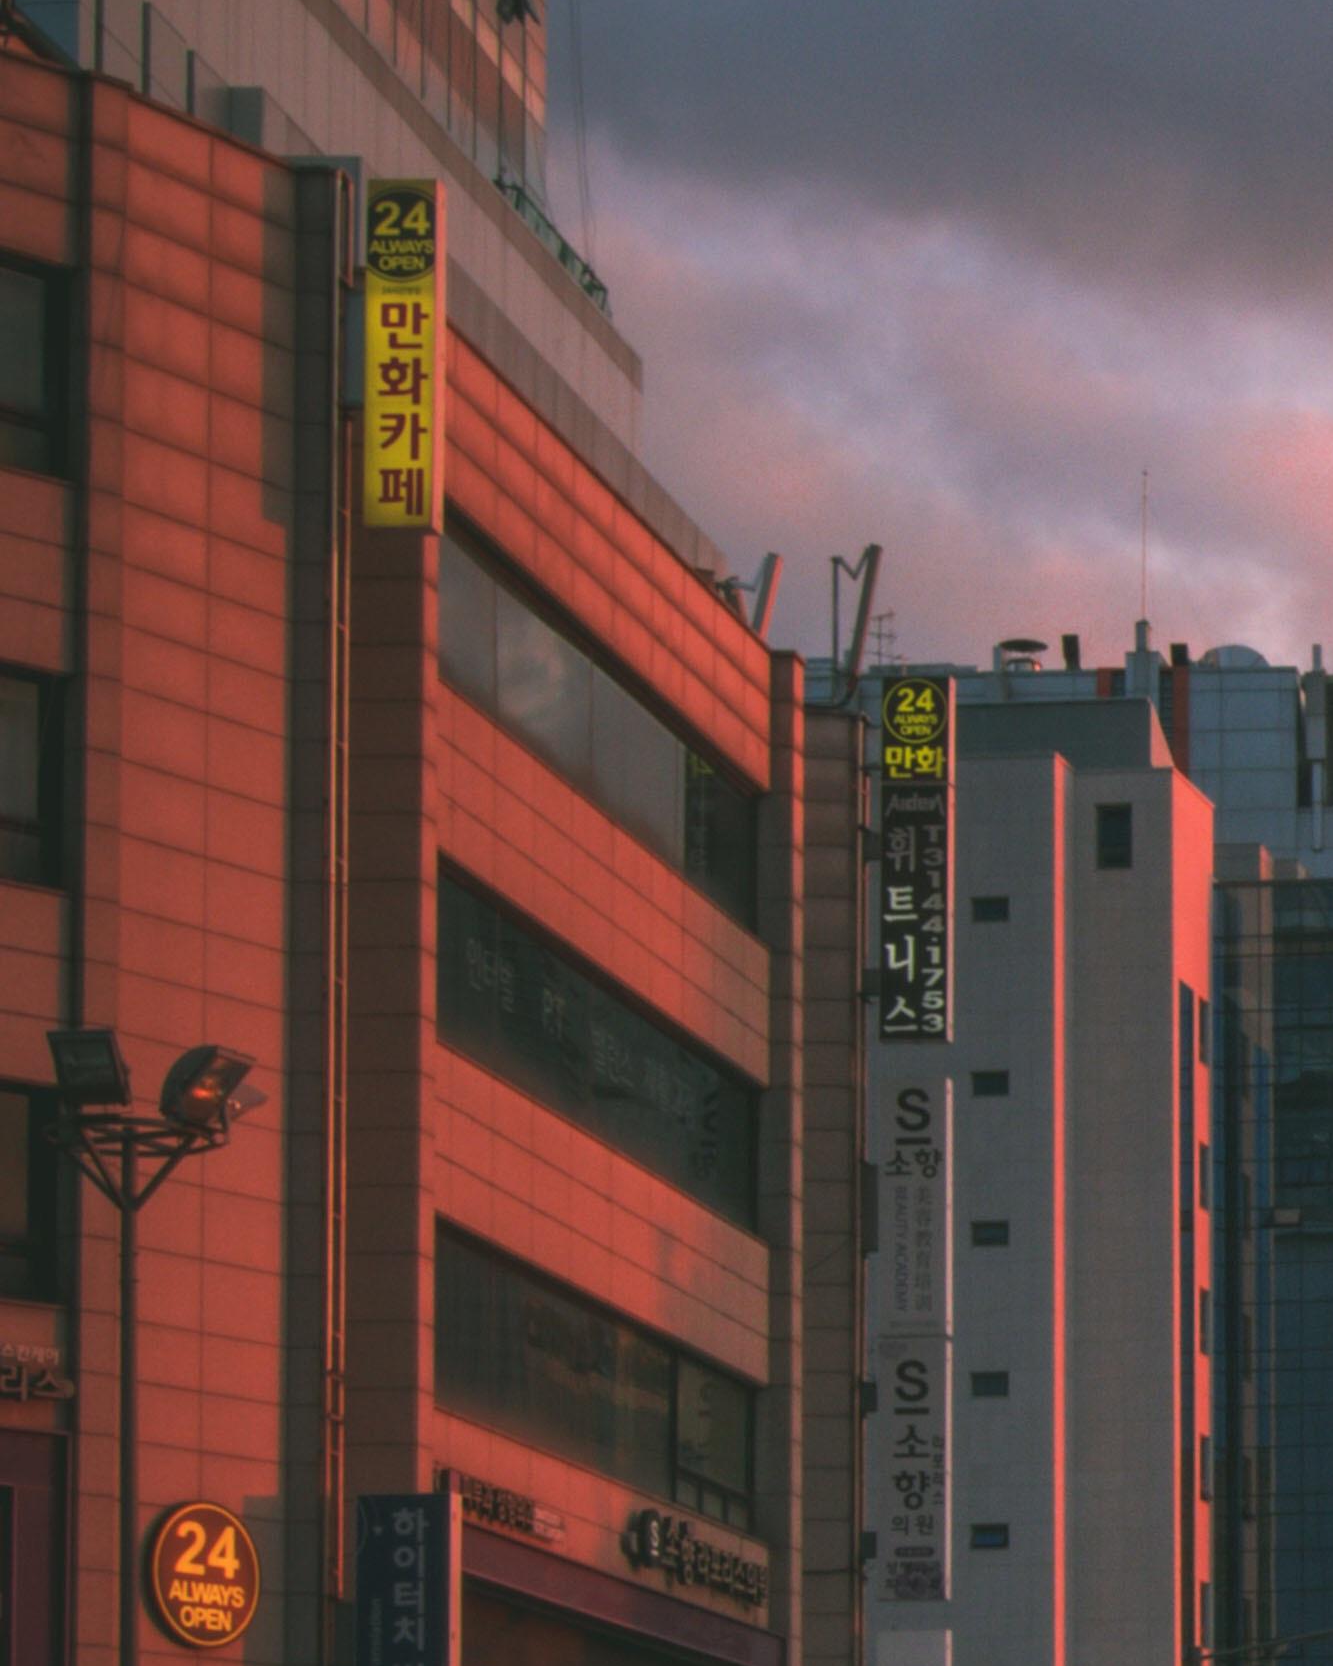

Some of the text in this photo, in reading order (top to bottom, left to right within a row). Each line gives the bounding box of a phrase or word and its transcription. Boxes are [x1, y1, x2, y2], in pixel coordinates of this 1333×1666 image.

[374, 201, 430, 235] 24
[369, 240, 434, 254] ALWAYS
[378, 256, 425, 271] OPEN
[378, 302, 430, 517] 만화카페
[896, 688, 935, 714] 24
[893, 714, 939, 726] ALWAYS
[900, 725, 932, 737] OPEN
[884, 746, 944, 779] 만화
[883, 825, 918, 1032] 휘트니스
[885, 1148, 944, 1179] 소향
[893, 1424, 931, 1511] 소향
[890, 1514, 935, 1536] 의원
[174, 1520, 241, 1580] 24
[168, 1579, 246, 1609] ALWAYS
[391, 1507, 429, 1652] 하이터치
[179, 1605, 233, 1632] OPEN
